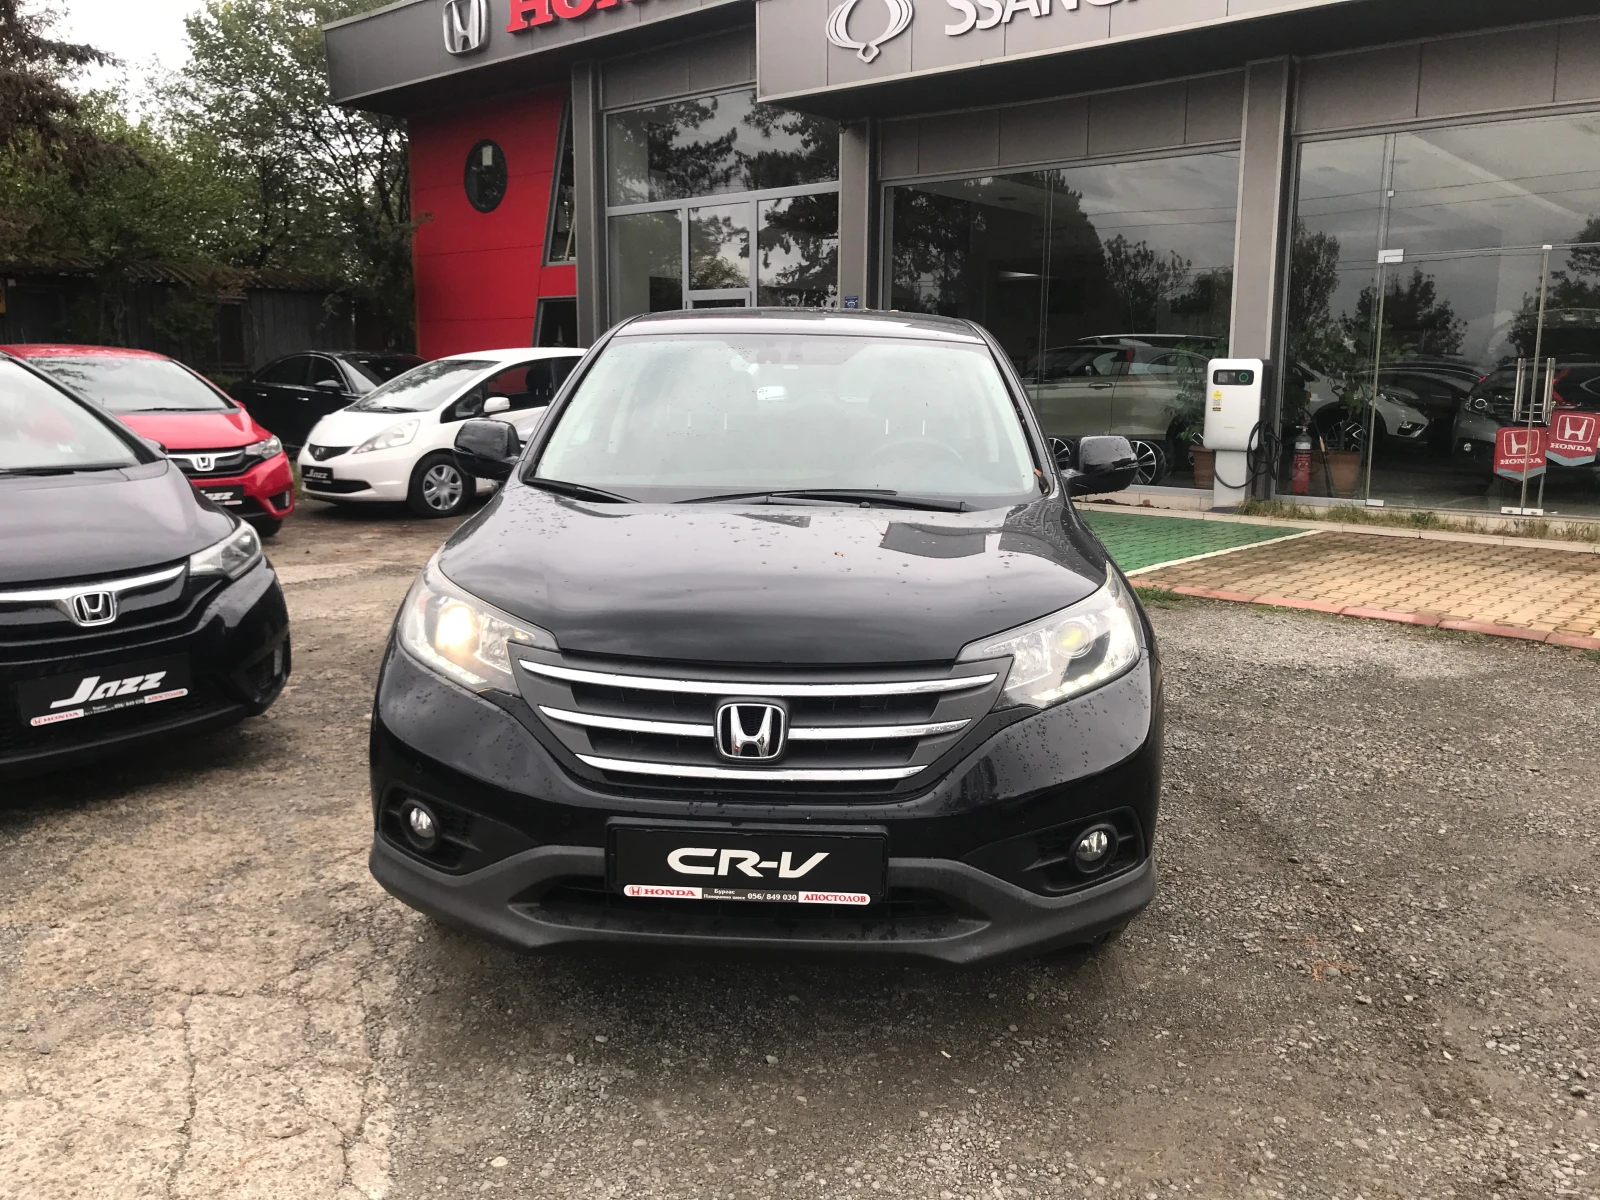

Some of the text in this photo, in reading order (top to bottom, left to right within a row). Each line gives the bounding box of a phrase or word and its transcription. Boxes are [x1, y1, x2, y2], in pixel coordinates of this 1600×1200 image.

[1550, 442, 1593, 453] HONDA
[50, 671, 167, 708] Jazz
[667, 847, 830, 878] CR-V
[644, 888, 696, 897] HONDA
[766, 893, 781, 901] 849
[804, 894, 867, 903] АПОСТОЛОВ
